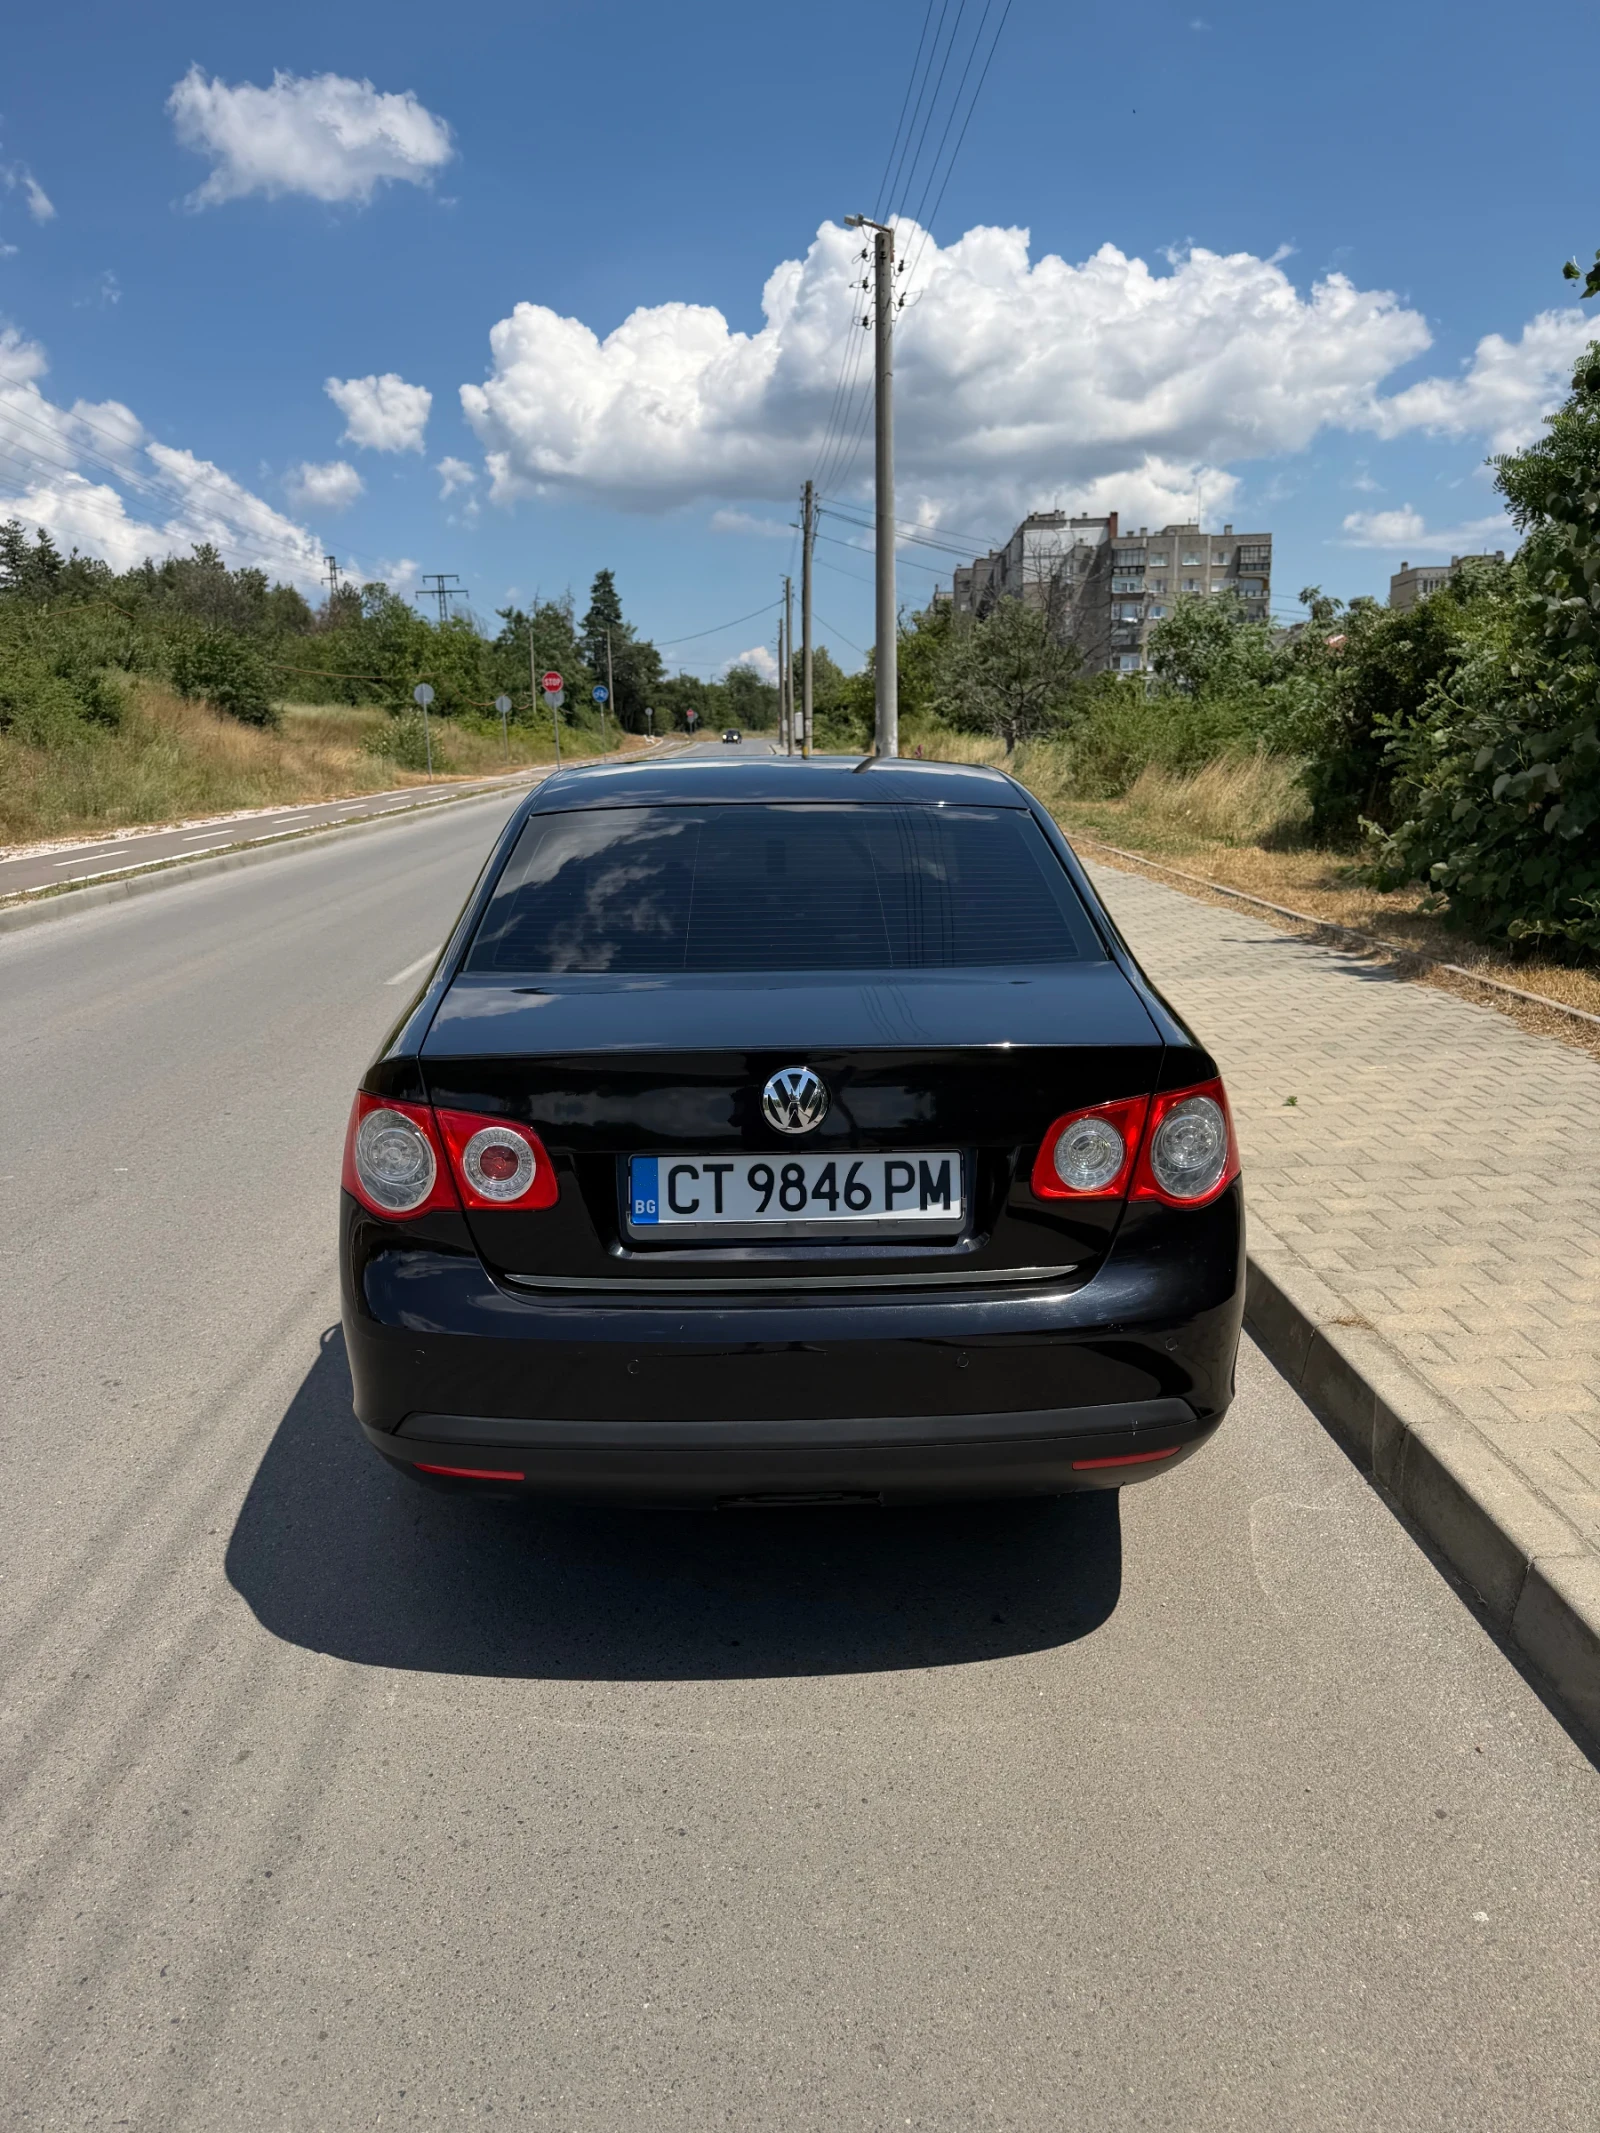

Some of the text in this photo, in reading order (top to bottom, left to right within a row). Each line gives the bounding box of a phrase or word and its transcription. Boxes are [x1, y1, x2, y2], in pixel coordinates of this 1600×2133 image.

[544, 678, 561, 686] STOP
[667, 1160, 951, 1215] CT 9846 PM
[635, 1199, 656, 1214] BG
